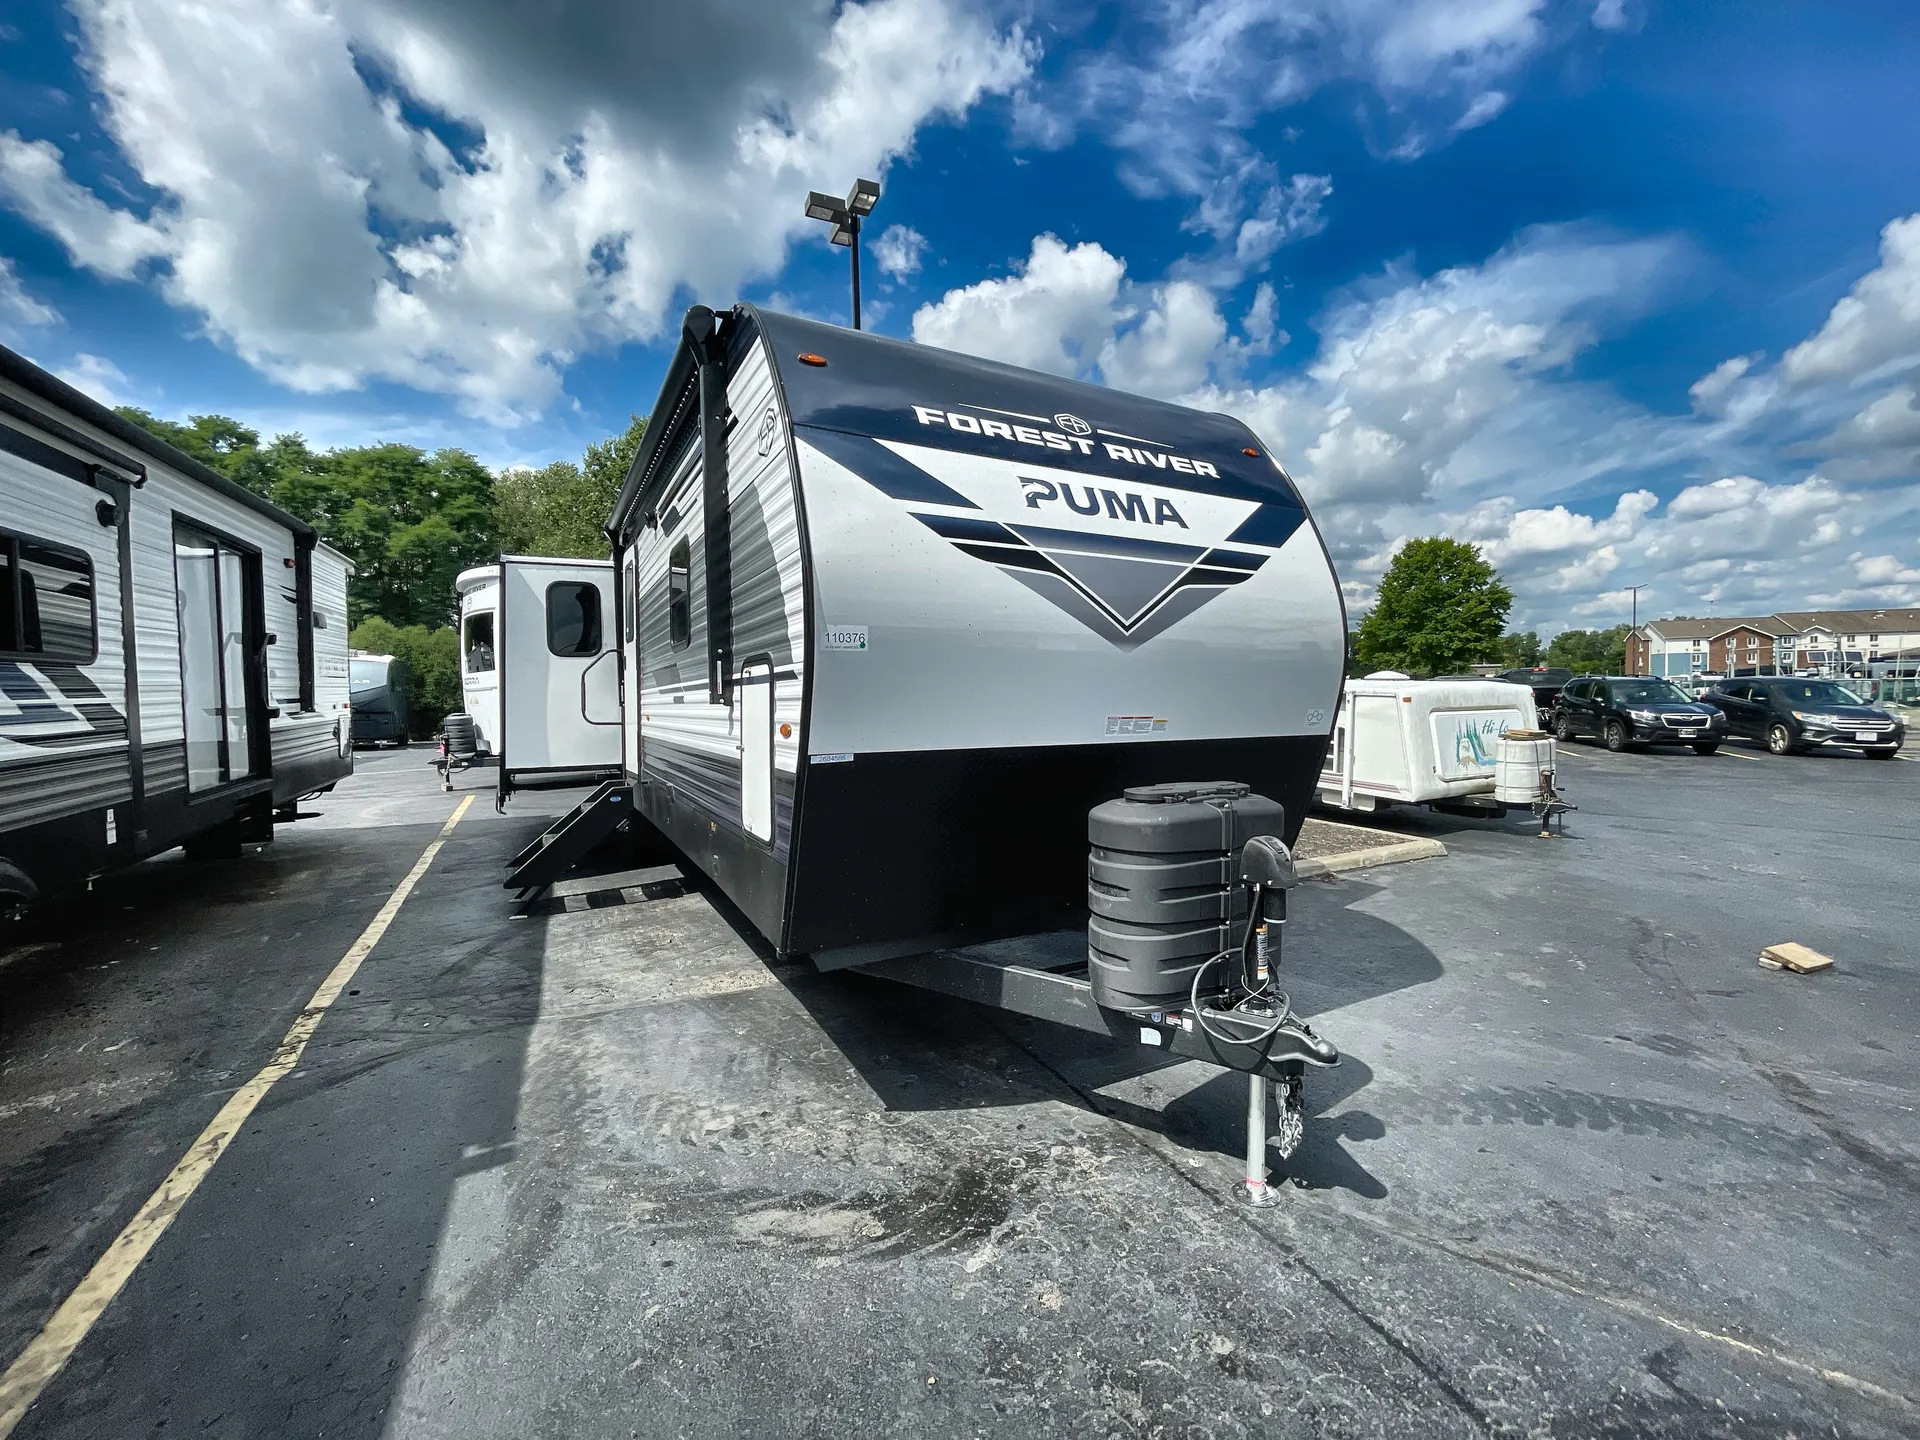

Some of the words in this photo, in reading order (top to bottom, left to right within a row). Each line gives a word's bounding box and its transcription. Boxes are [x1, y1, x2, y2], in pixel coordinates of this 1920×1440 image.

[911, 405, 1094, 455] FOREST
[1101, 442, 1221, 479] RIVER
[1017, 475, 1190, 530] PUMA
[825, 632, 866, 643] 110376
[1482, 719, 1508, 734] Hi-Lo
